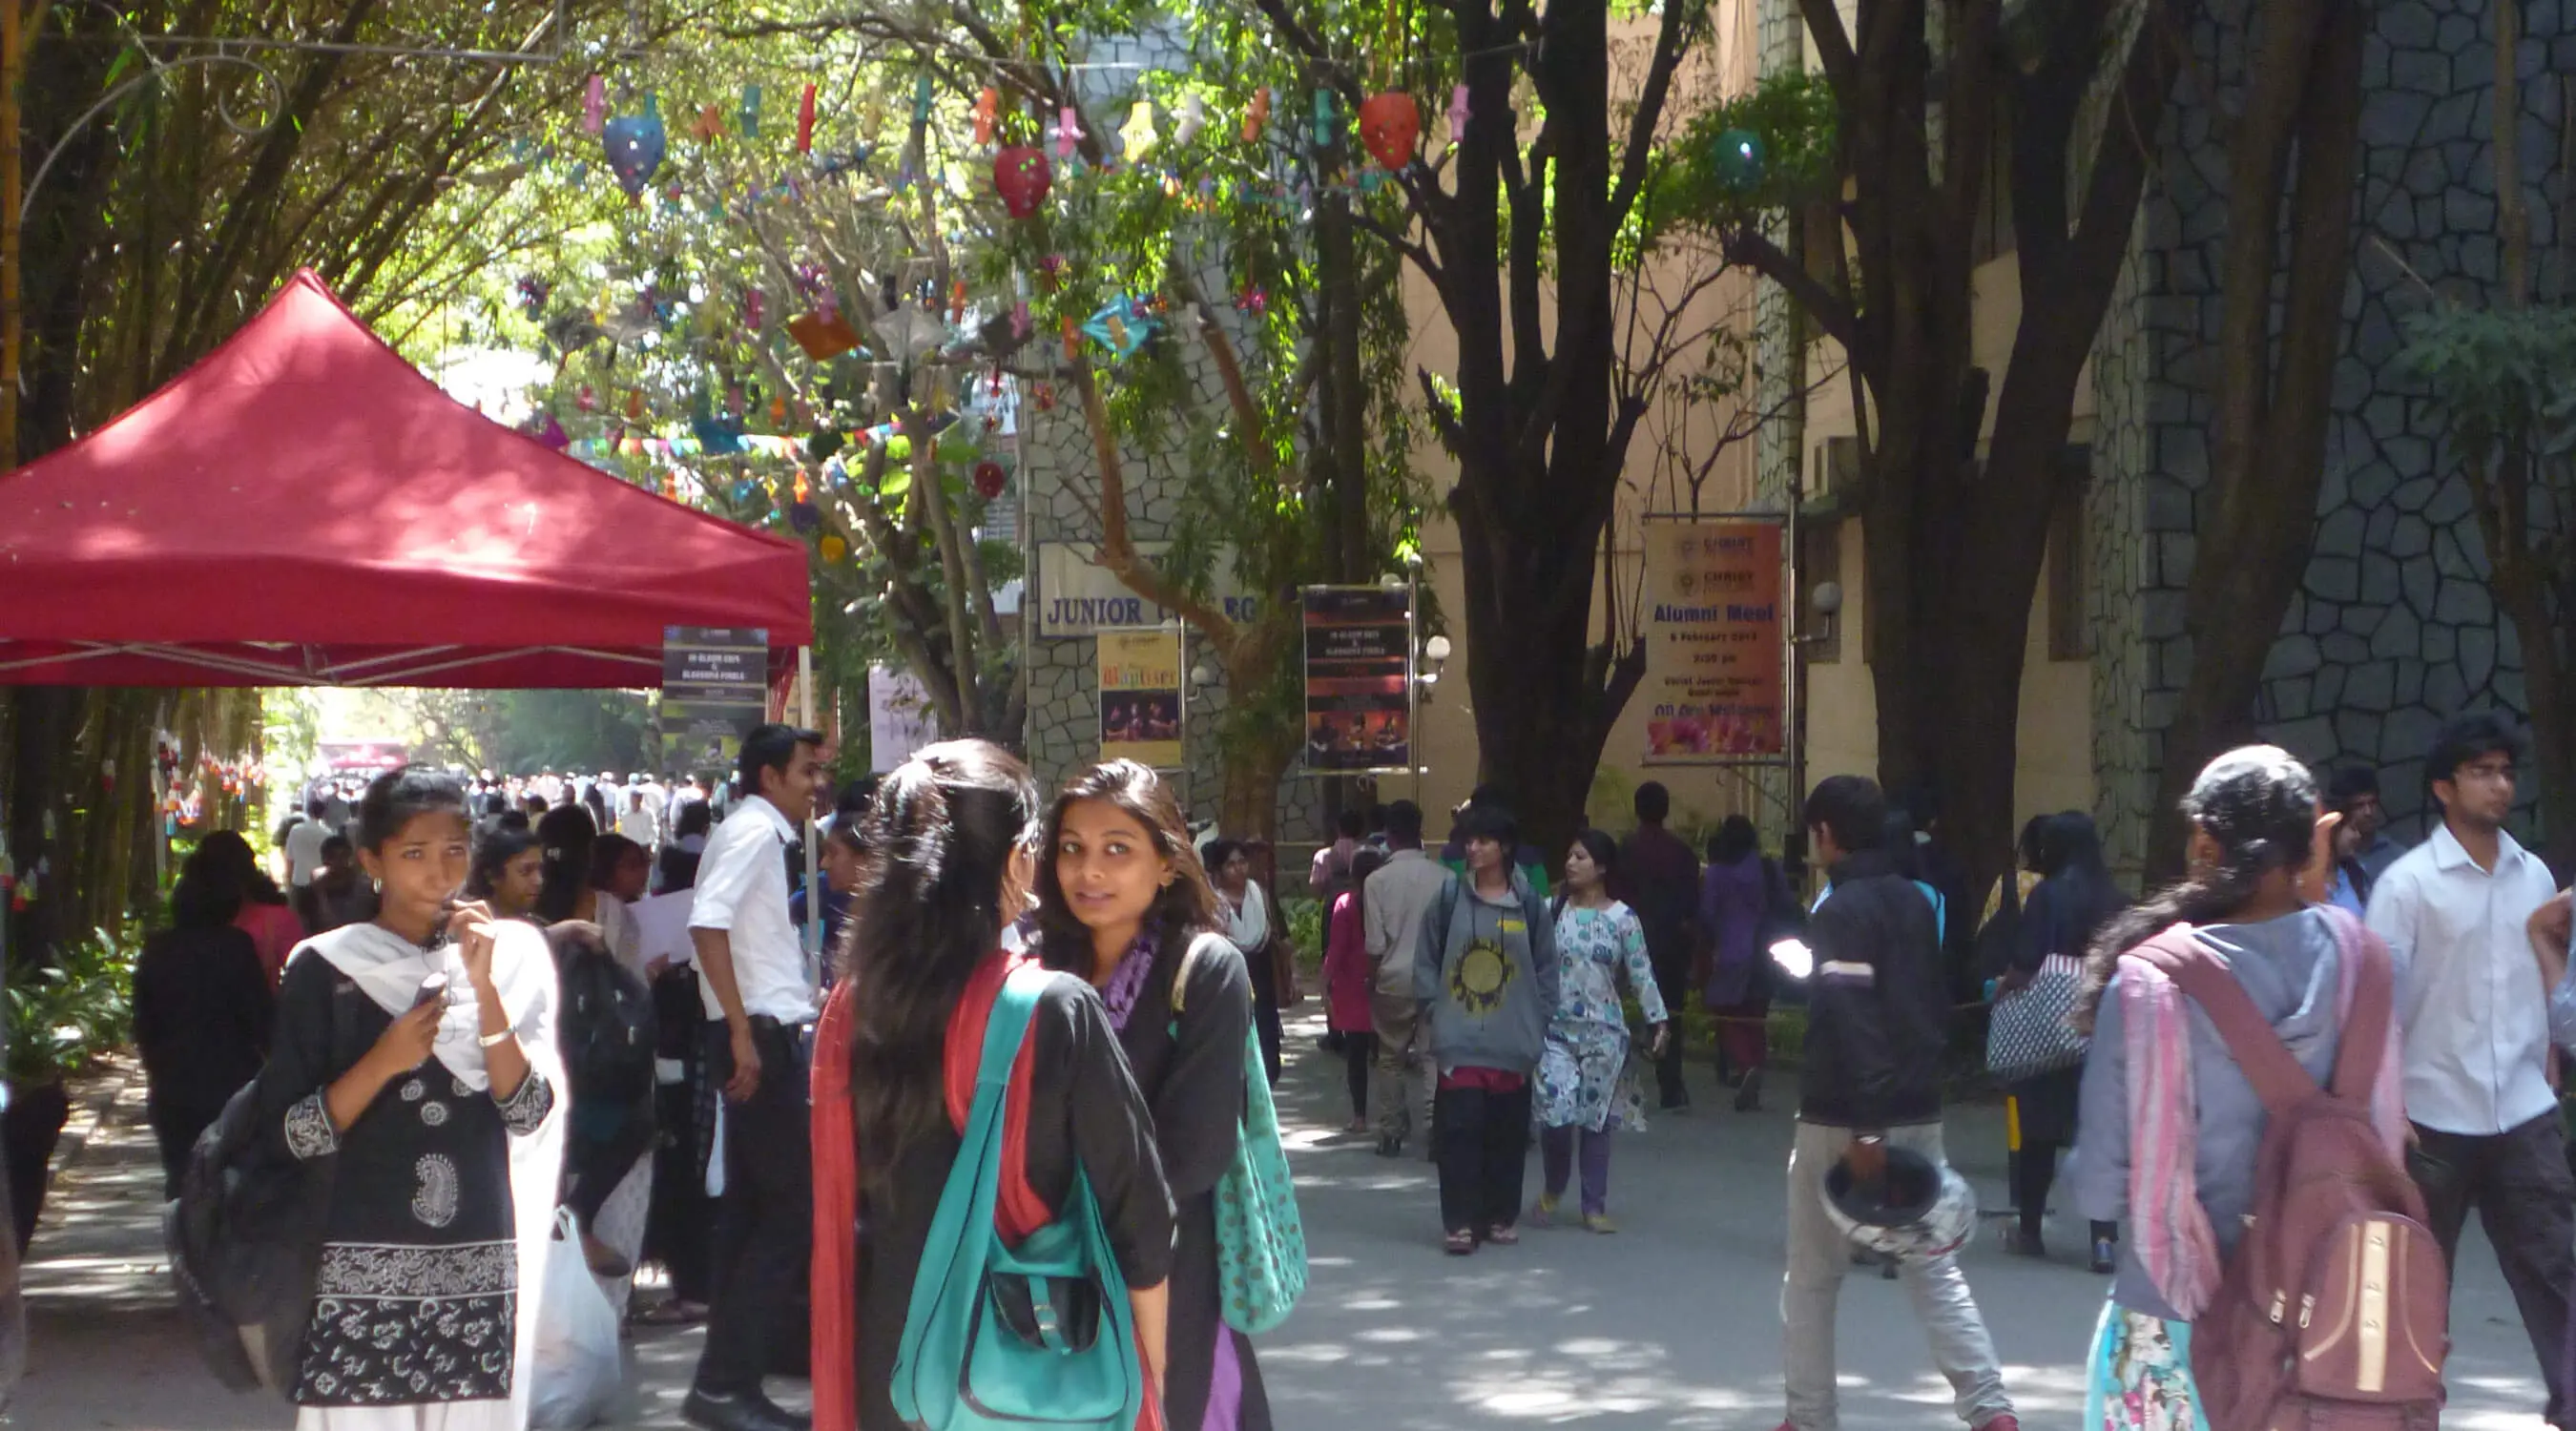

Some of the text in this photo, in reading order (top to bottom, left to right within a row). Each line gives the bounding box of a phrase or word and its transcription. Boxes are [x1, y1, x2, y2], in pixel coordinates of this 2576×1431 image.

[1048, 597, 1142, 624] JUNIOR
[1654, 603, 1774, 622] Alumni Meet
